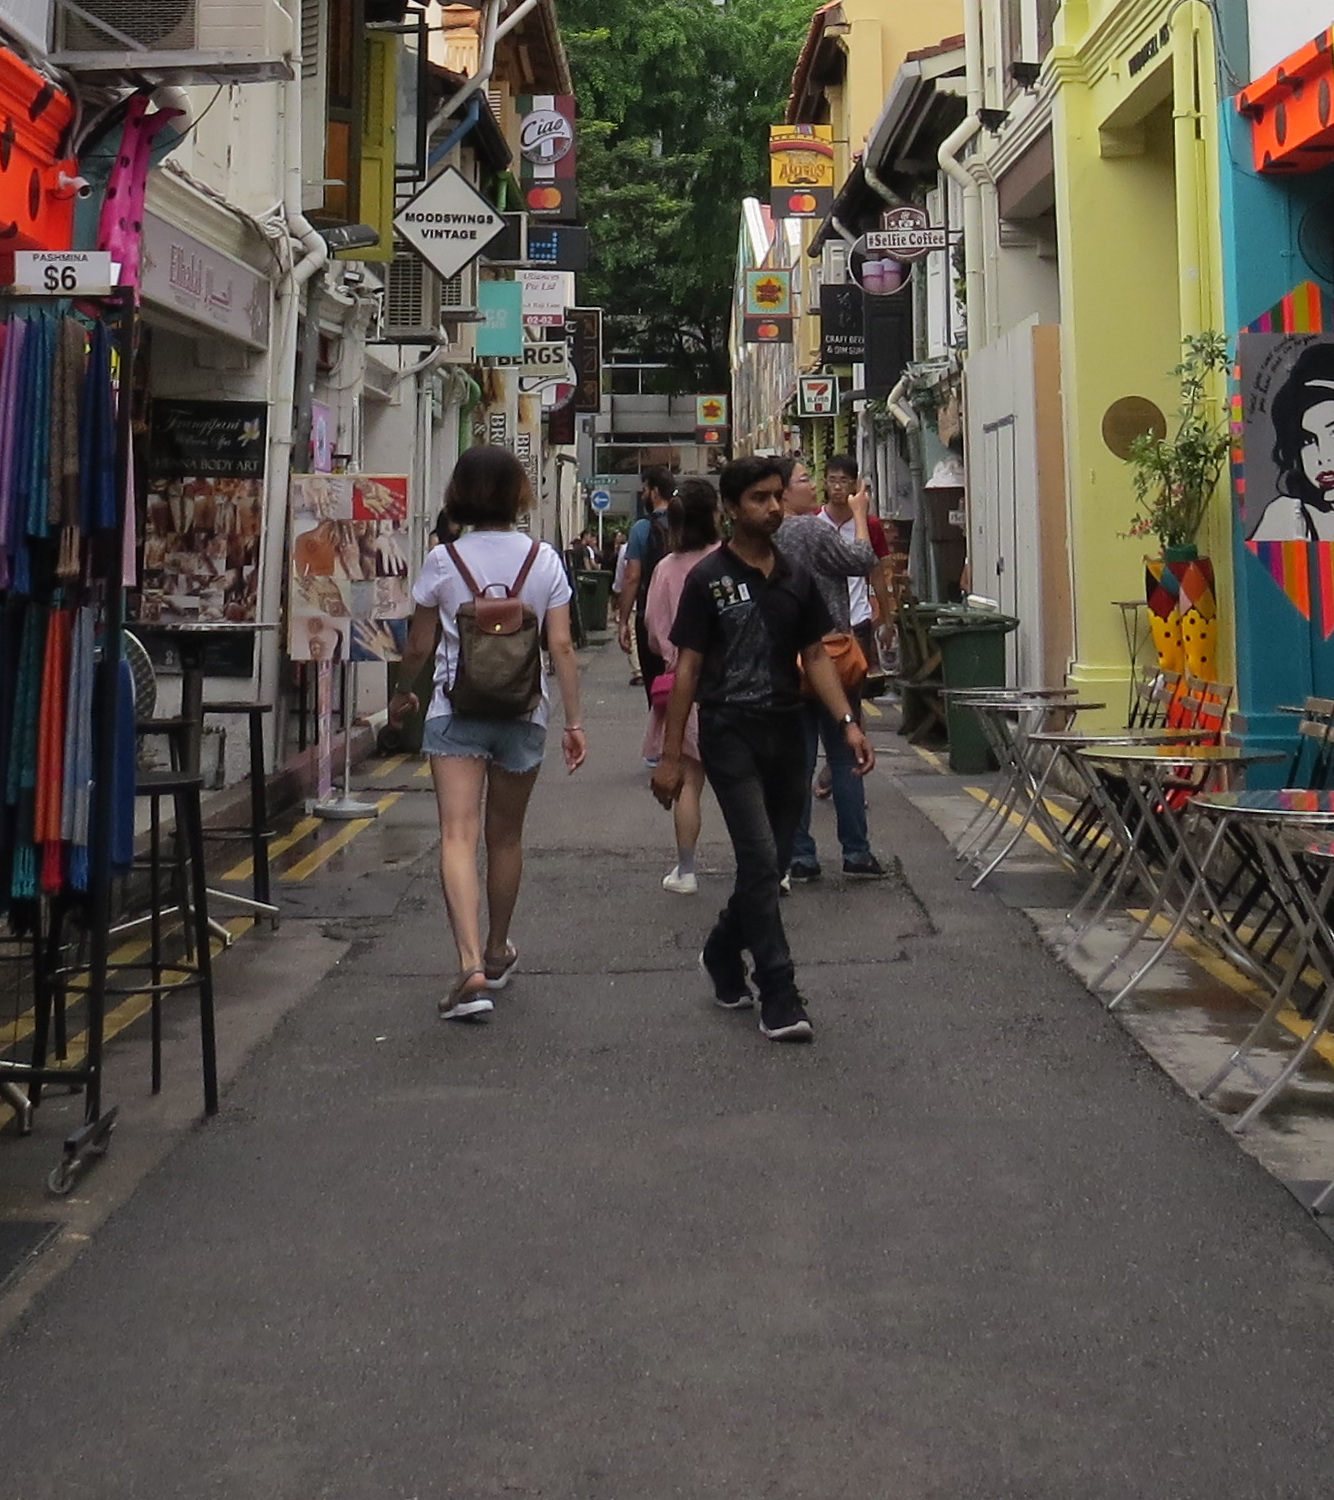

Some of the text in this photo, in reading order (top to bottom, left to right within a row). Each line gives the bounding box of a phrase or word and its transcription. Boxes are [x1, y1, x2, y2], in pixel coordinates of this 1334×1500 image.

[521, 118, 563, 147] Ciao
[405, 212, 494, 224] MOODSWINGS
[421, 228, 478, 240] VINTAGE
[869, 232, 945, 248] #Selfie Coffee
[32, 252, 88, 263] PASHMINA
[43, 265, 77, 293] $6
[527, 315, 553, 325] 02-02
[201, 459, 233, 470] BODY
[236, 460, 259, 471] ART
